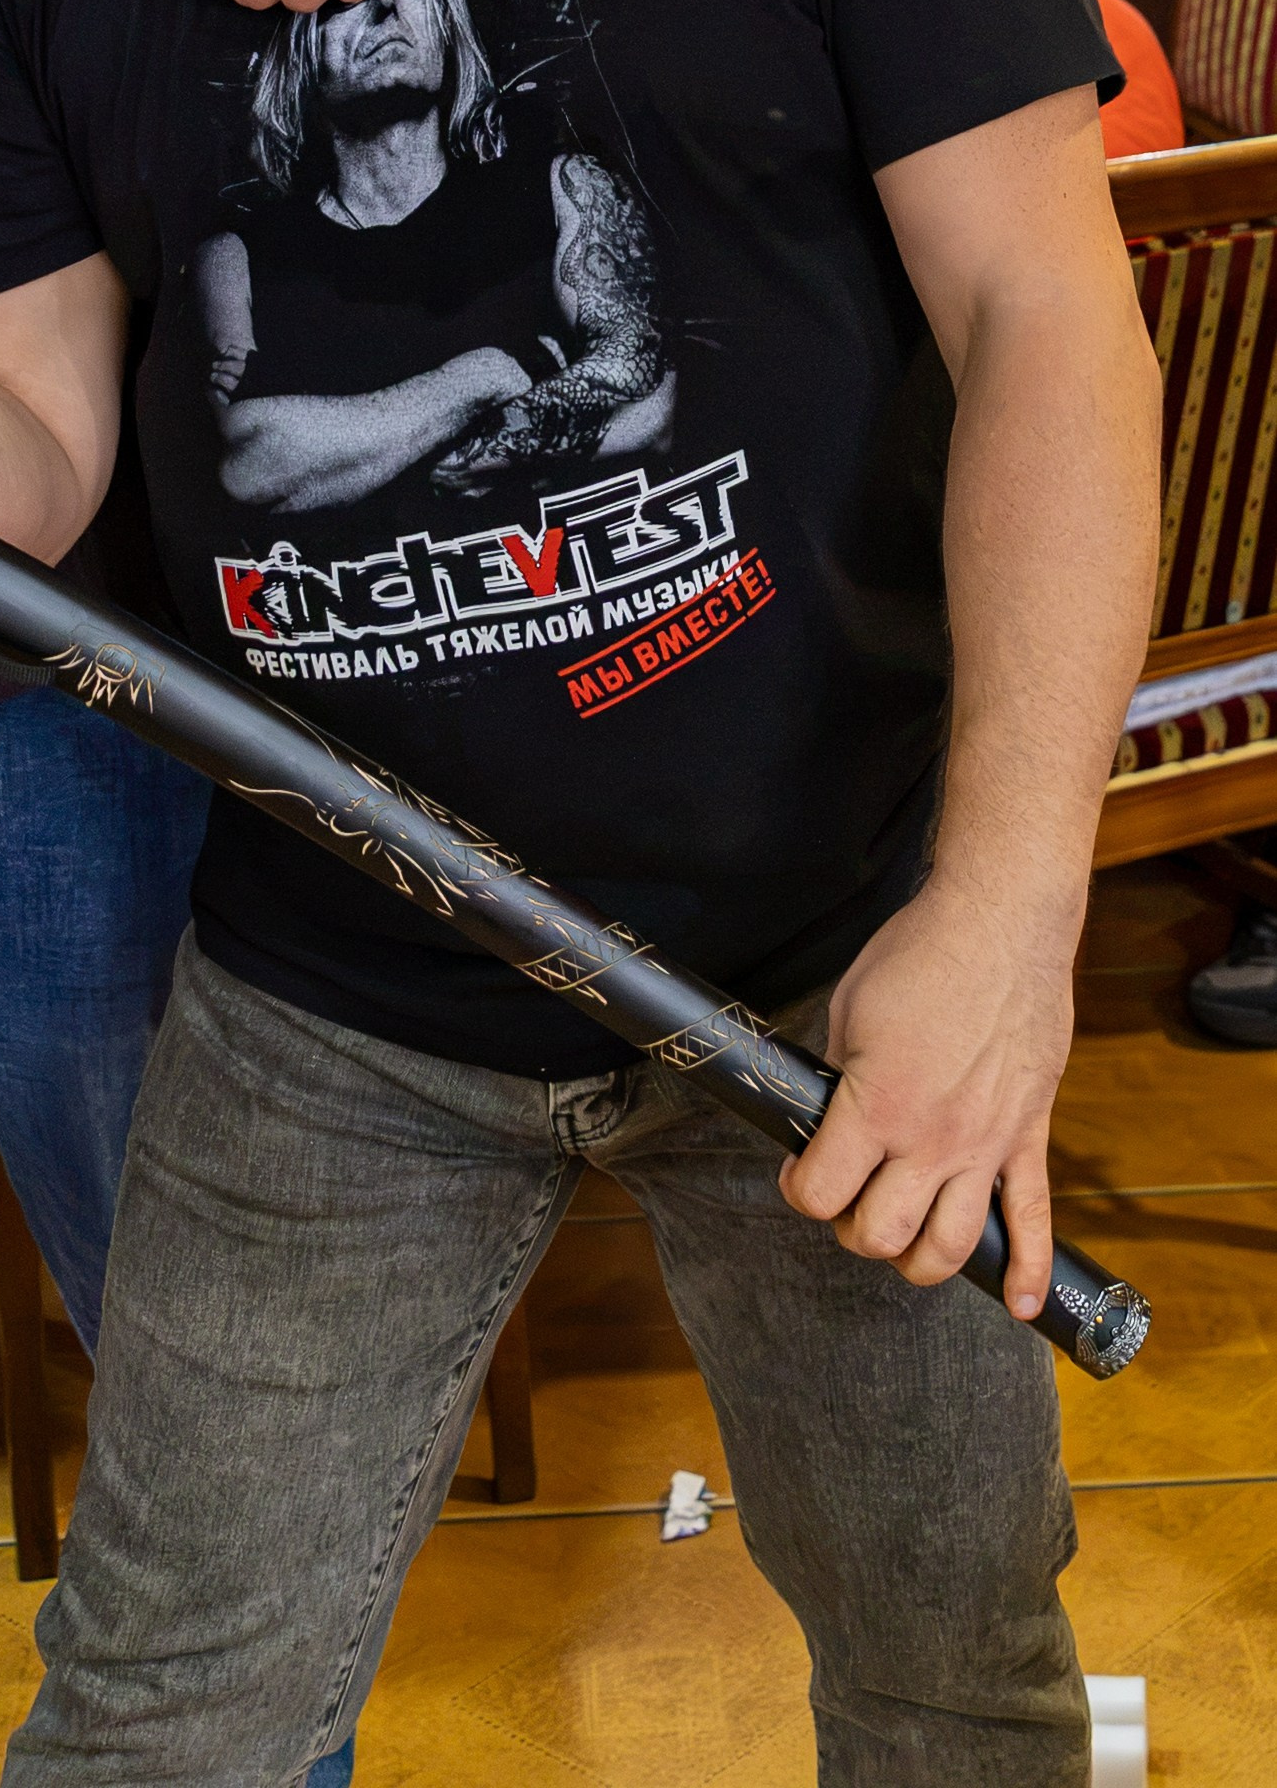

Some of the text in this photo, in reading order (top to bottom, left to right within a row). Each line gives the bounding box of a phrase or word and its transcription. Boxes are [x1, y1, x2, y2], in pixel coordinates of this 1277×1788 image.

[246, 549, 745, 680] ФЕСТИВАЛЬ ТЯЖЕЛОЙ МУЗЫКИ
[566, 656, 634, 709] МЫ
[632, 558, 773, 674] ВМЕСТЕ!
